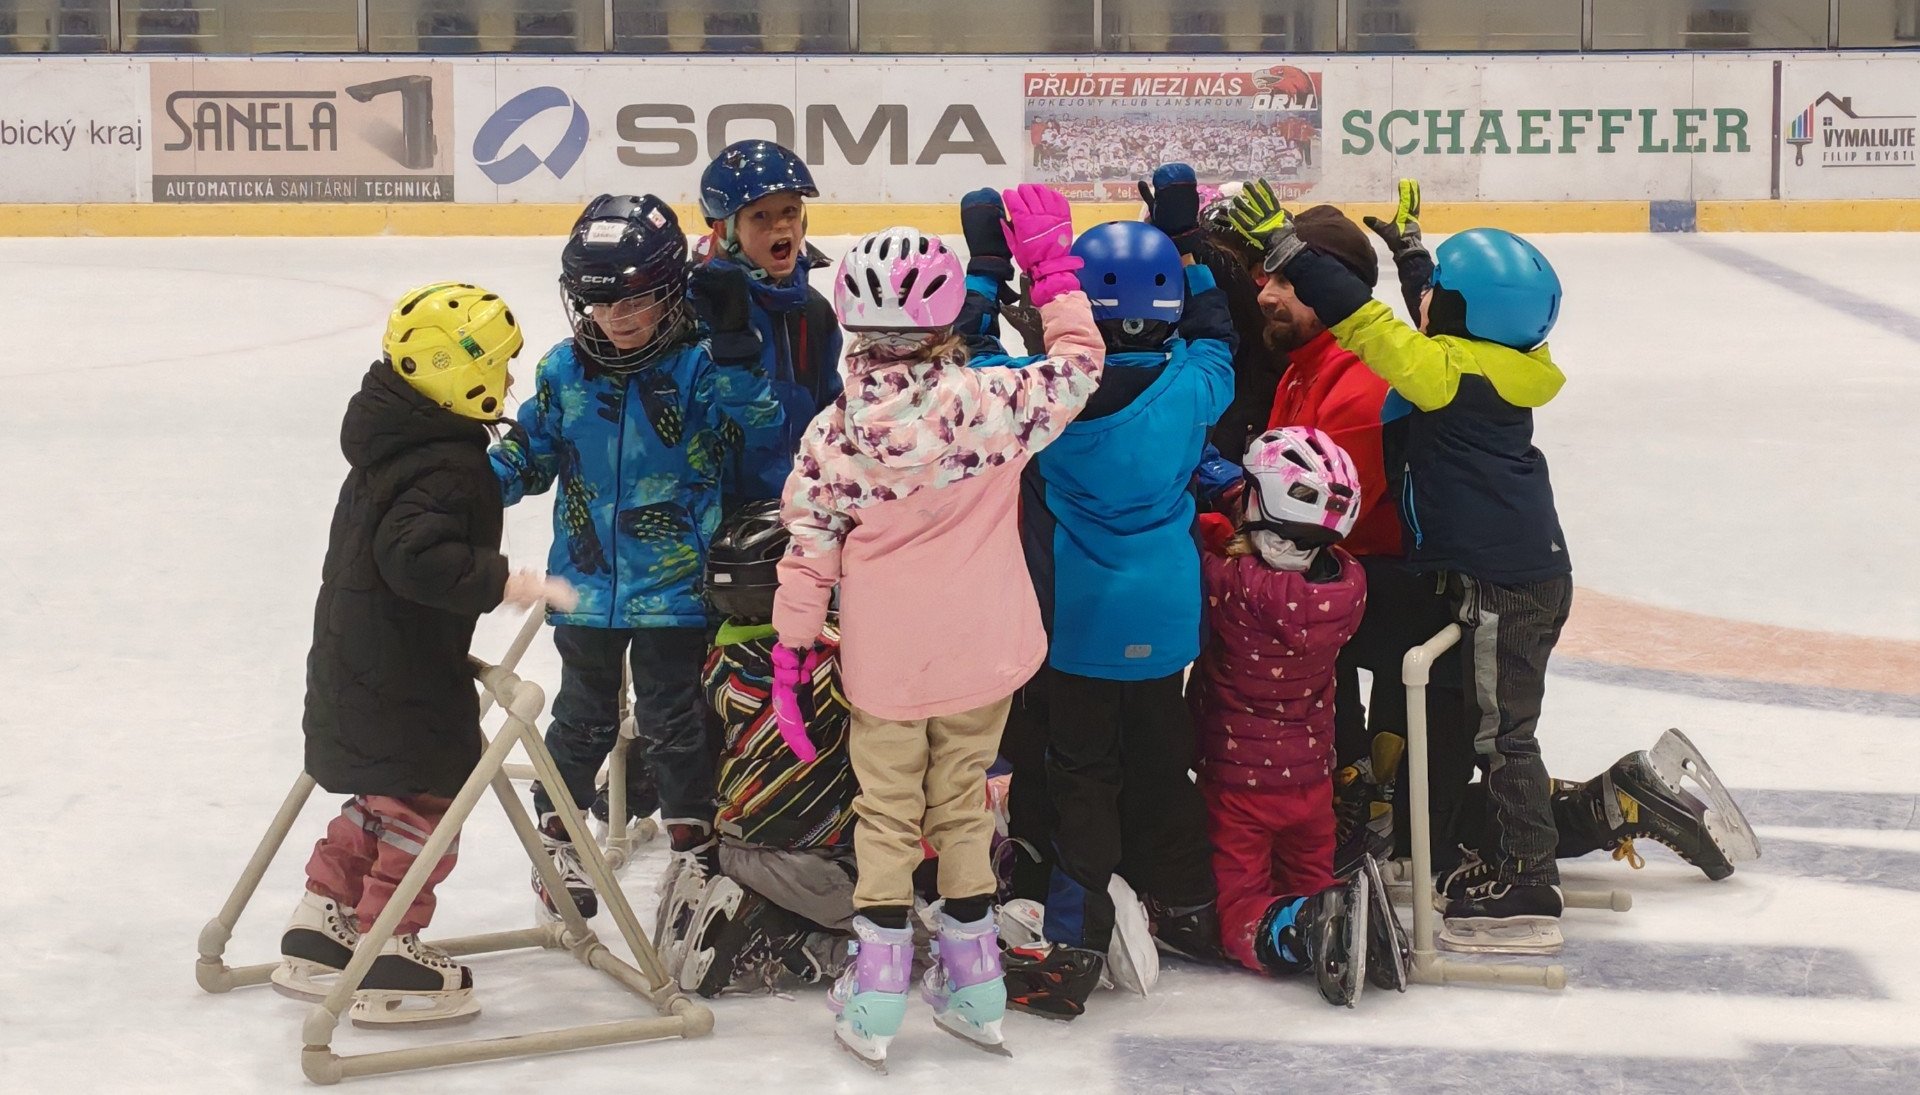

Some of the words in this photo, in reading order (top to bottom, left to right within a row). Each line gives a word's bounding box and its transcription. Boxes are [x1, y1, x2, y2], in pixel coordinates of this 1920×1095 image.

[1131, 77, 1189, 96] MEZI
[1193, 72, 1244, 96] NÁS
[1250, 93, 1318, 111] ORLI
[164, 90, 337, 152] SANELA
[1341, 107, 1750, 155] SCHAEFFLER
[90, 119, 142, 152] kraj
[616, 103, 1007, 167] SOMA
[1823, 128, 1916, 148] VYMALUJTE
[1823, 151, 1857, 162] FILIP
[166, 177, 274, 198] AUTOMATICKÁ
[280, 177, 358, 198] SANITÁRNÍ
[581, 275, 616, 284] CCM
